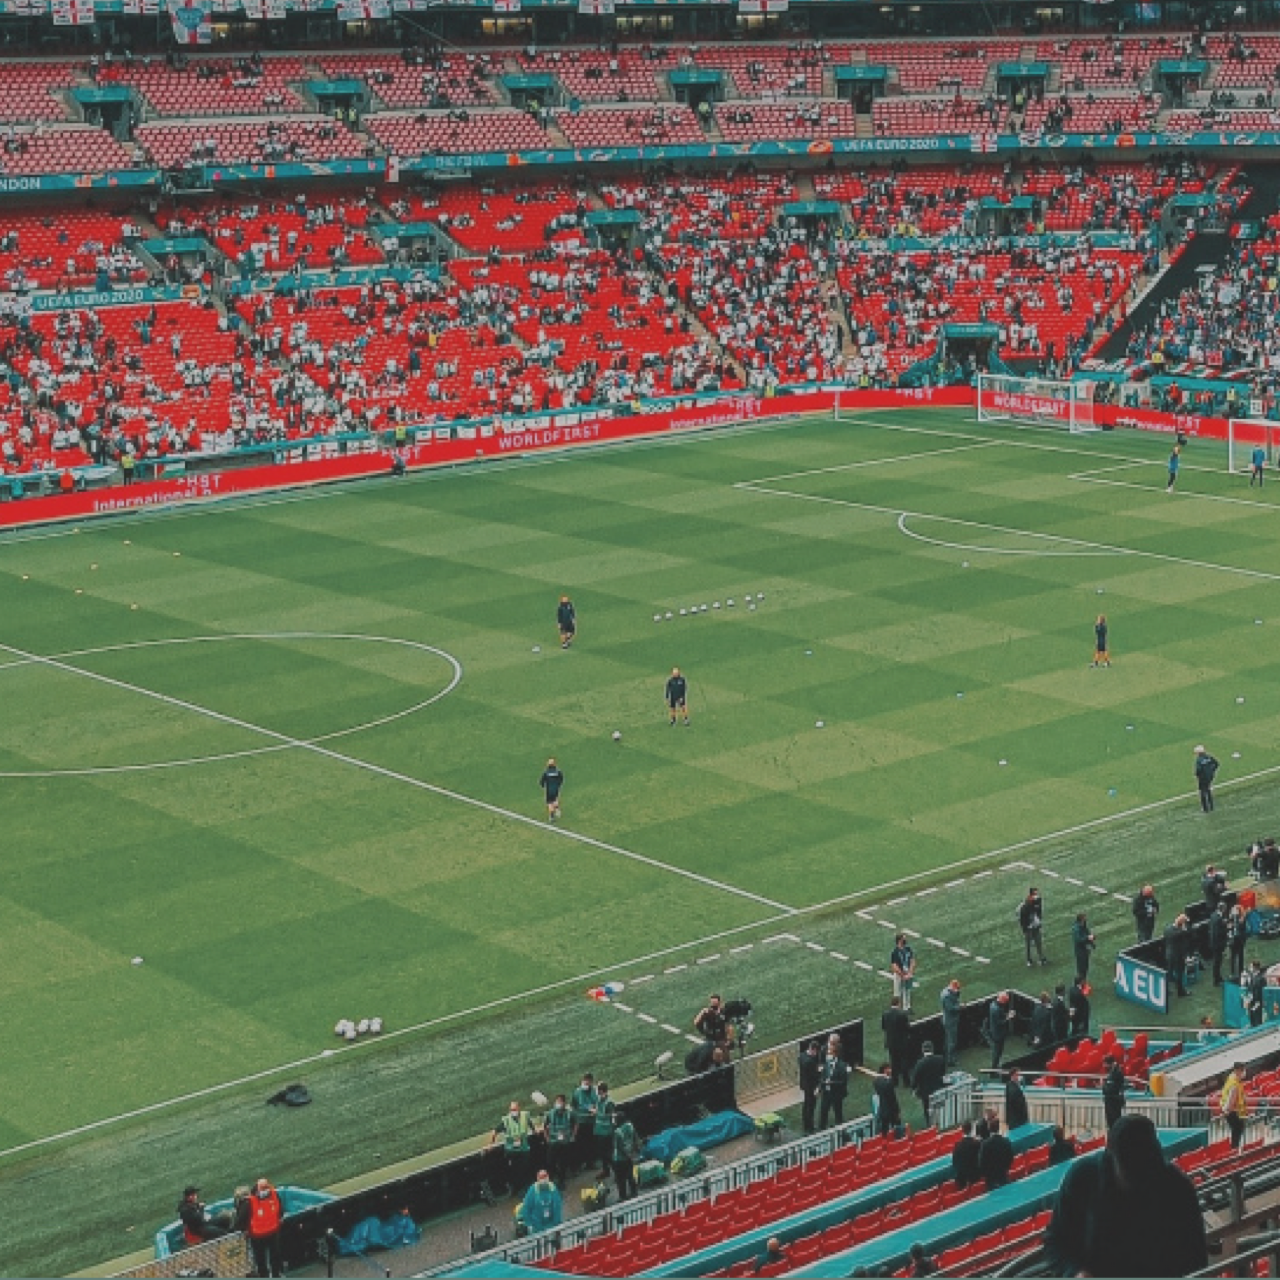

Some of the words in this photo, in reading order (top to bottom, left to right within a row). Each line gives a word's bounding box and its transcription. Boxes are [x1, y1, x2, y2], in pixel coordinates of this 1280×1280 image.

[111, 288, 145, 303] 2020
[499, 423, 600, 450] WORLDFIRST
[93, 486, 199, 513] International
